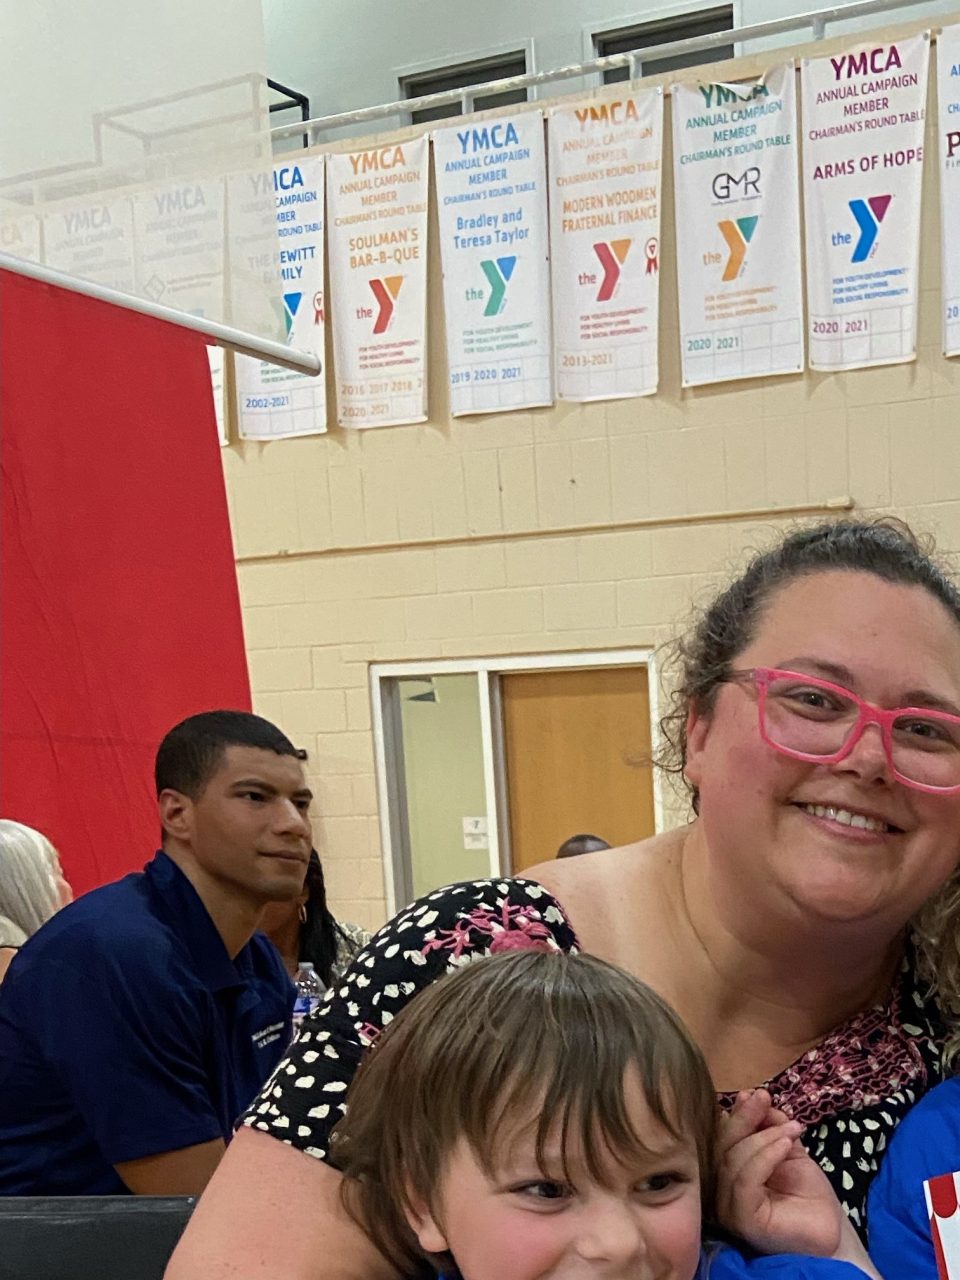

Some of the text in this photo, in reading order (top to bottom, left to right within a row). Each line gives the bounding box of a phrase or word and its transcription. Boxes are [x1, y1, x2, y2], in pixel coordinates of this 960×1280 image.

[830, 45, 902, 80] YMCA
[816, 73, 918, 105] ANNUAL CAMPAIGN
[575, 99, 639, 132] YMCA
[686, 100, 783, 130] ANNUAL CAMPAIGN
[843, 97, 889, 117] MEMBER
[713, 125, 757, 143] MEMBER
[809, 108, 925, 141] CHAIRMAN'S ROUND TABLE
[457, 122, 519, 154] YMCA
[766, 135, 791, 150] TABLE
[350, 147, 406, 175] YMCA
[445, 149, 530, 173] ANNUAL CAMPAIGN
[638, 160, 659, 174] TABLE
[813, 147, 923, 180] ARMS OF HOPE
[469, 169, 507, 186] MEMBER
[712, 166, 761, 199] GMR
[563, 186, 657, 214] MODERN WOODMEN
[457, 207, 522, 231] Bradley and
[562, 205, 657, 233] FRATERNAL FINANCE
[349, 228, 418, 251] SOULMAN'S
[454, 227, 529, 249] Teresa Taylor
[832, 232, 851, 246] the
[351, 247, 419, 269] BAR-B-QUE
[703, 252, 721, 265] the
[579, 273, 596, 285] the
[466, 287, 484, 301] the
[357, 307, 373, 320] the
[813, 320, 868, 333] 2020 2021
[688, 337, 739, 351] 2020 2021
